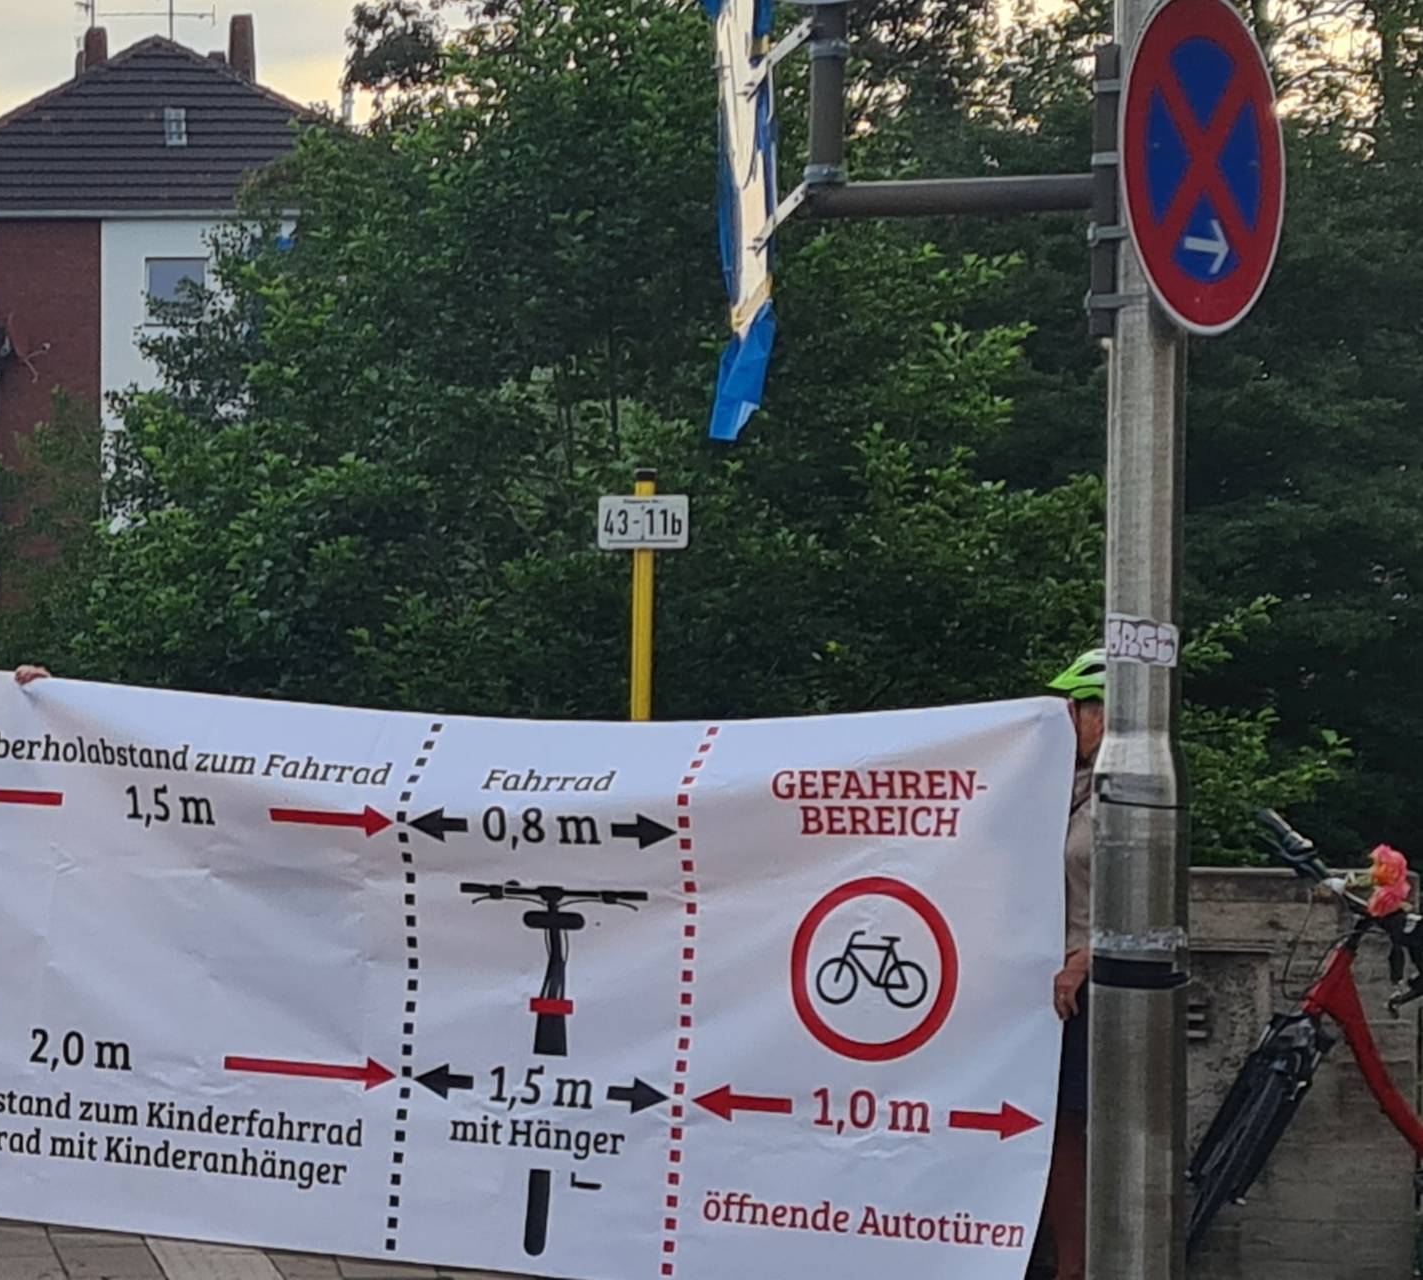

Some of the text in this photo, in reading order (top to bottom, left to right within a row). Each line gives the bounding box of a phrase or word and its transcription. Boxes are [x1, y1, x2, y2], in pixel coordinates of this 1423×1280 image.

[194, 752, 256, 775] zum
[261, 754, 393, 786] Fahrrad
[481, 768, 617, 792] Fahrrad
[772, 770, 987, 801] GEFAHREN-
[125, 784, 216, 828] 1,5 m
[482, 806, 602, 851] 0,8 m
[799, 805, 960, 837] BEREICH
[29, 1028, 132, 1072] 2,0 m
[489, 1065, 593, 1111] 1,5 m
[78, 1100, 138, 1126] zum
[145, 1101, 363, 1147] Kinderfahrrad
[813, 1087, 931, 1135] 1,0 m
[49, 1131, 98, 1162] mit
[104, 1135, 347, 1189] Kinderanhänger
[449, 1115, 626, 1160] mit Hänger
[703, 1190, 1024, 1247] öffnende Autotüren
